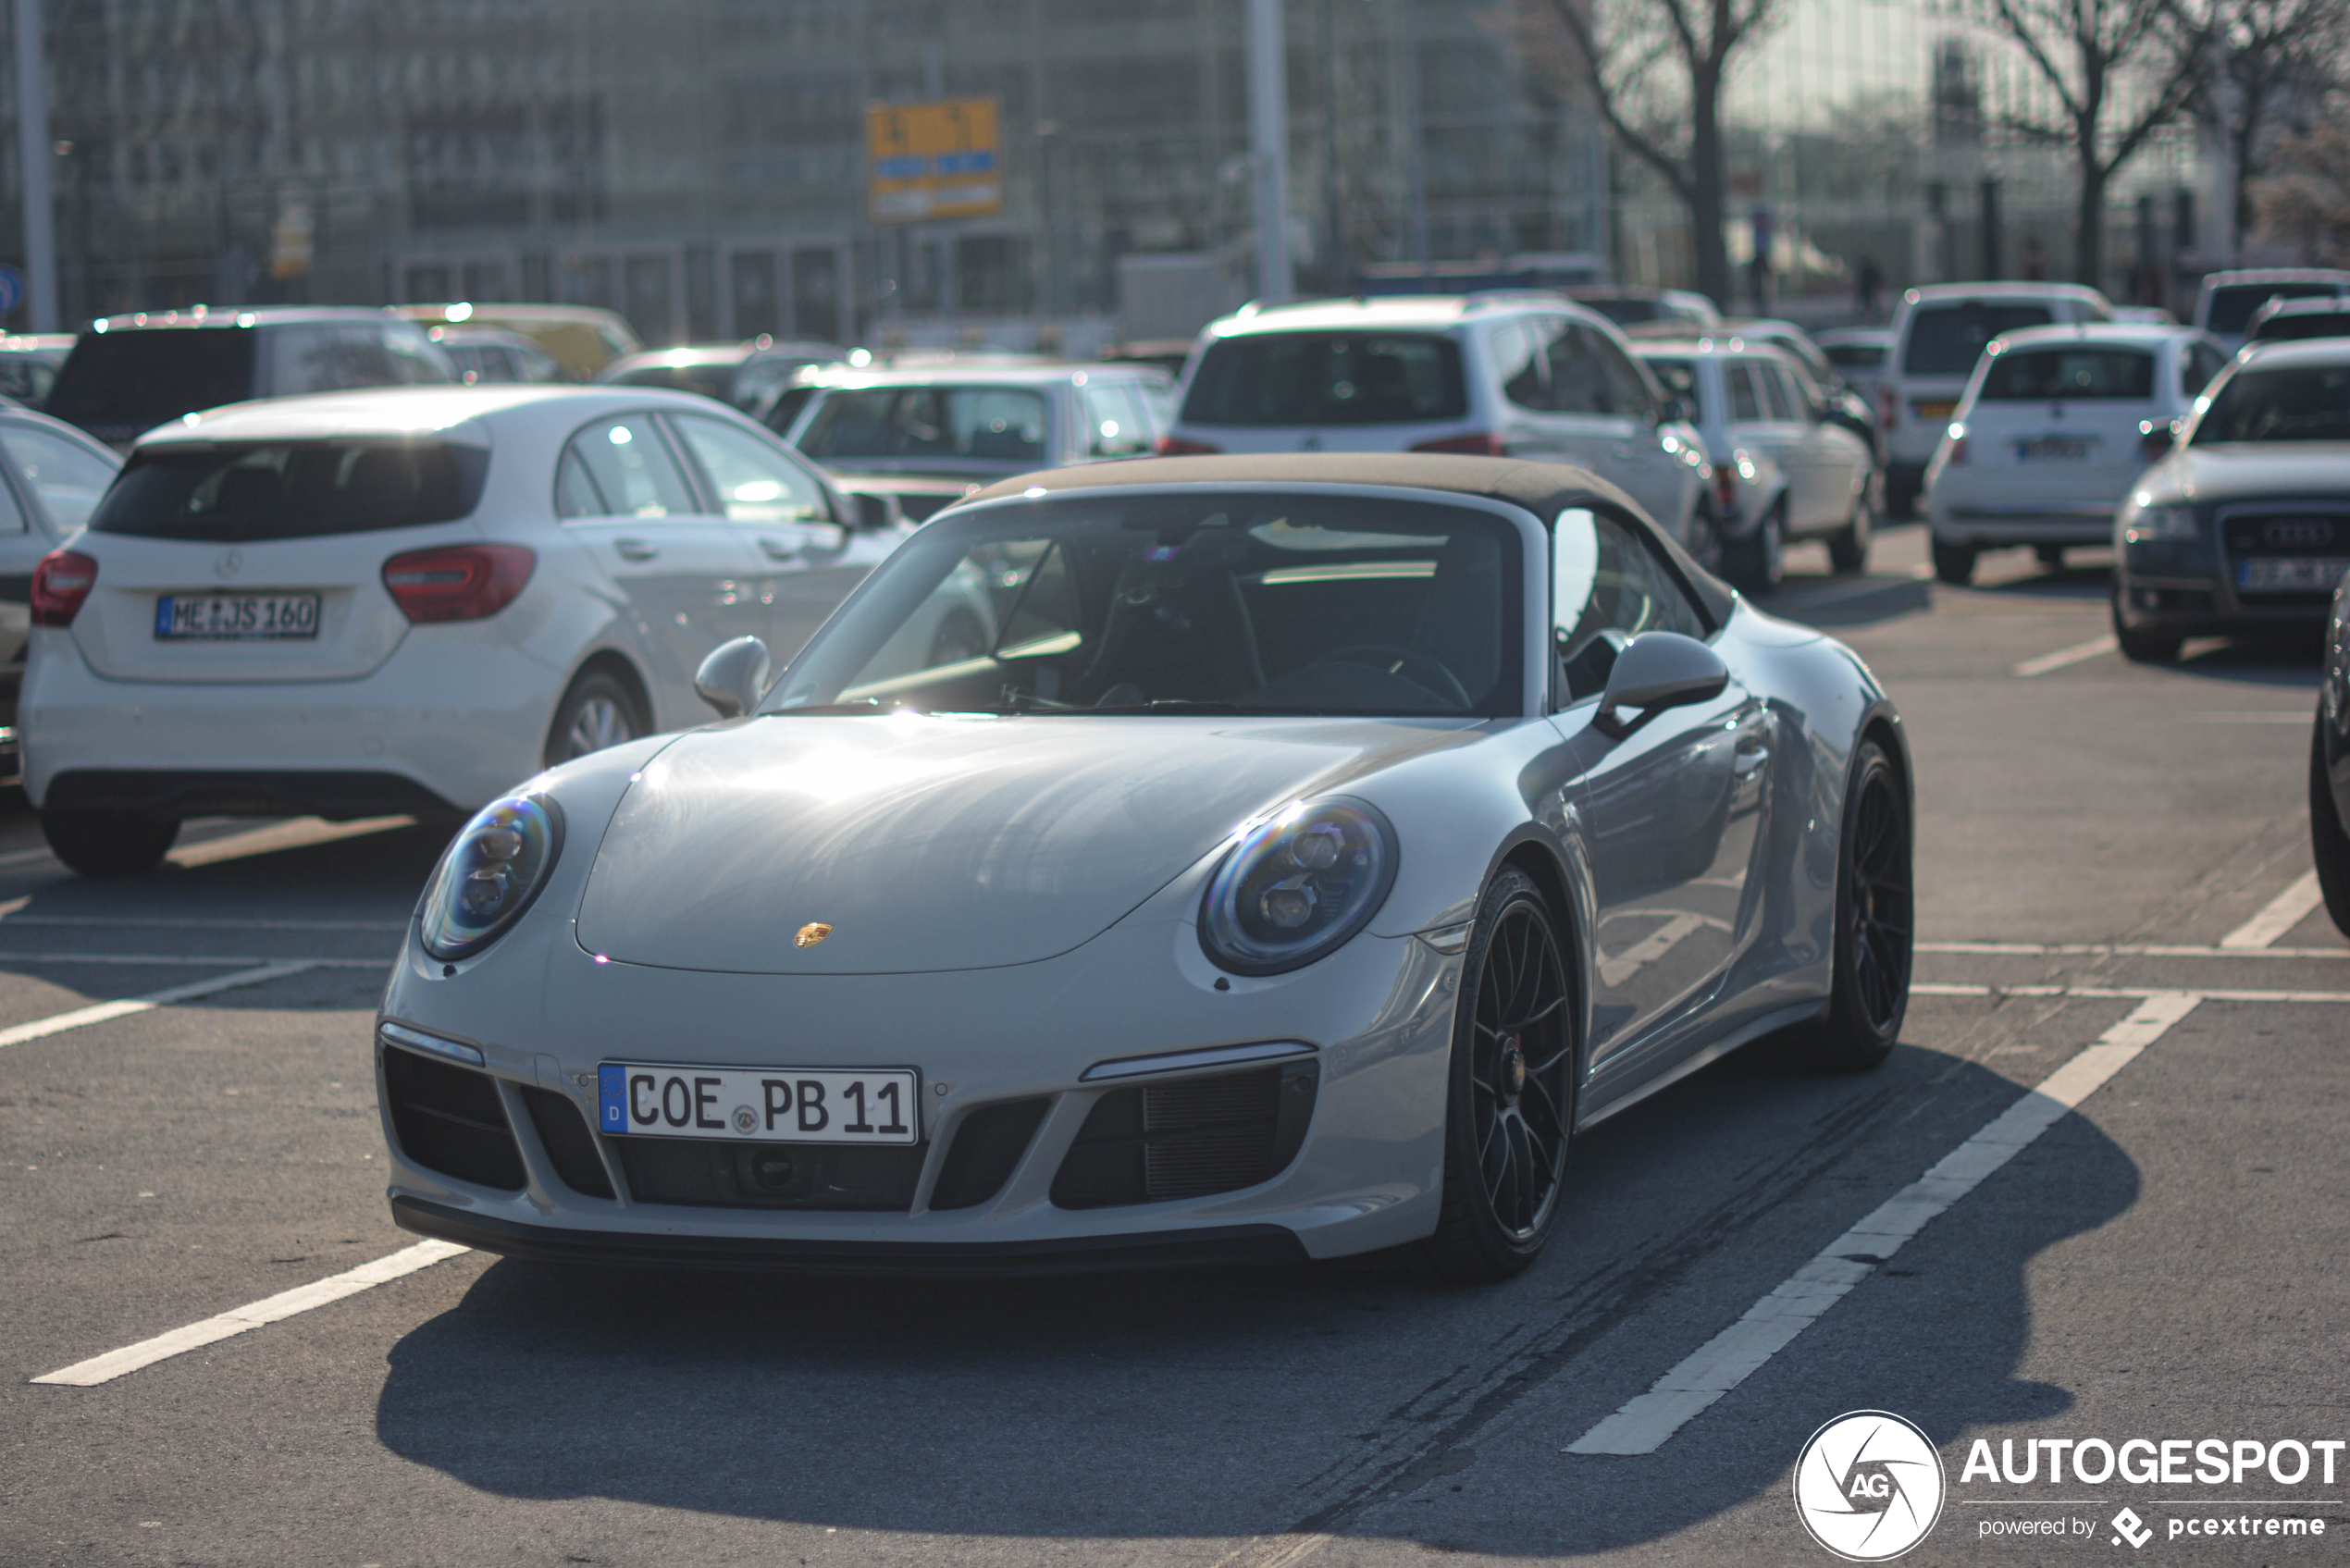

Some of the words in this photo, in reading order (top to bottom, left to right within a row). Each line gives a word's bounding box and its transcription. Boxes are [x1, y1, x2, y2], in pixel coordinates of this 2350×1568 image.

[173, 602, 204, 629] ME
[224, 601, 257, 629] JS
[264, 599, 313, 628] 160
[609, 1105, 620, 1120] D
[630, 1074, 725, 1129] COE
[761, 1079, 829, 1131] PB
[843, 1081, 909, 1134] 11
